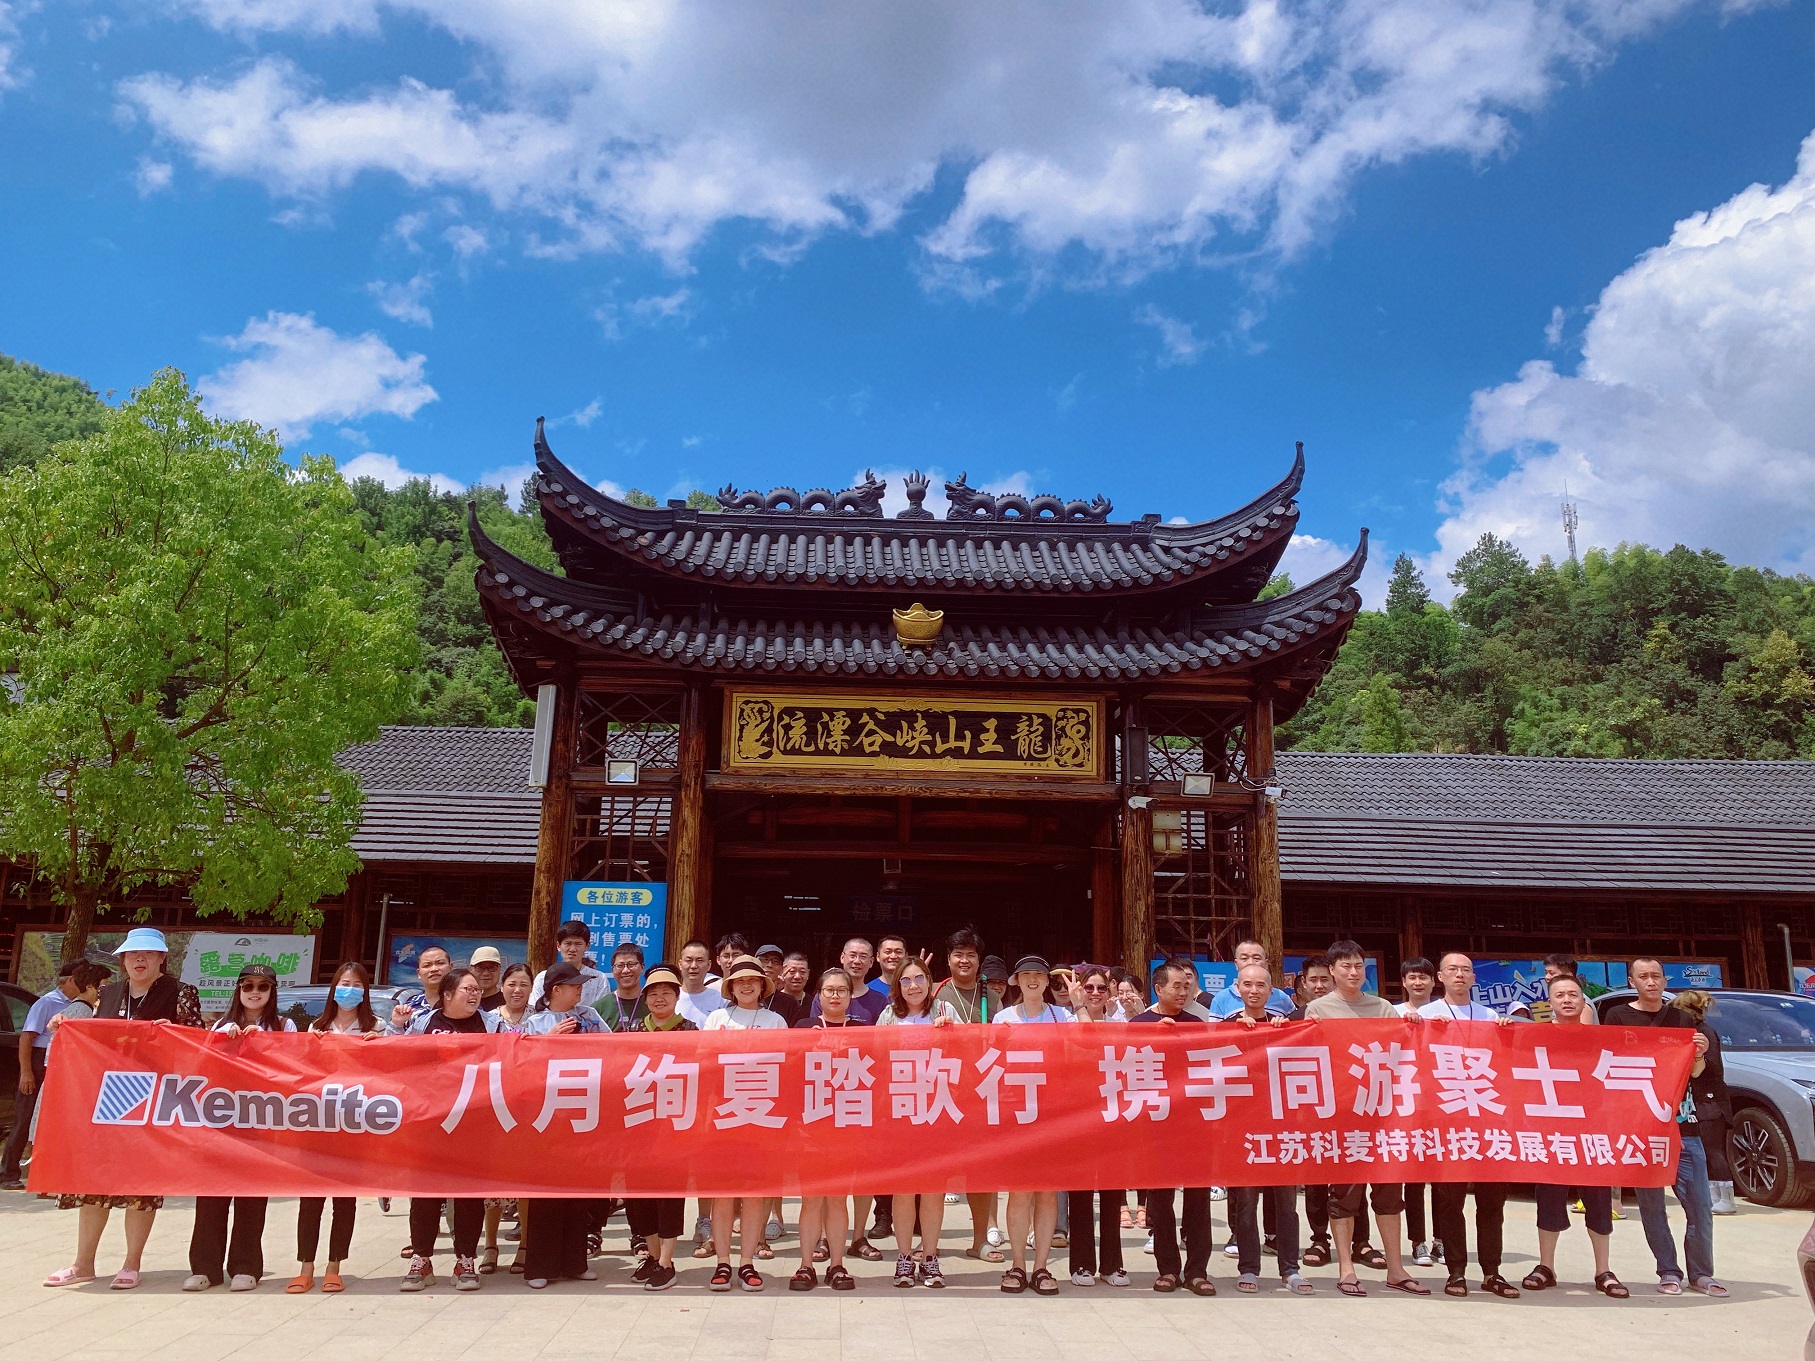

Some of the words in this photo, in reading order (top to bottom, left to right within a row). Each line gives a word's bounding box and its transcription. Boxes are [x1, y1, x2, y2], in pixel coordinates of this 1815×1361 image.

[586, 890, 643, 905] 各位游客
[154, 1075, 402, 1134] Kemaite
[440, 1047, 1047, 1134] 八月绚夏踏歌行
[1098, 1043, 1674, 1123] 携手同游聚士气
[1244, 1129, 1671, 1168] 江苏科麦特科技发展有限公司
